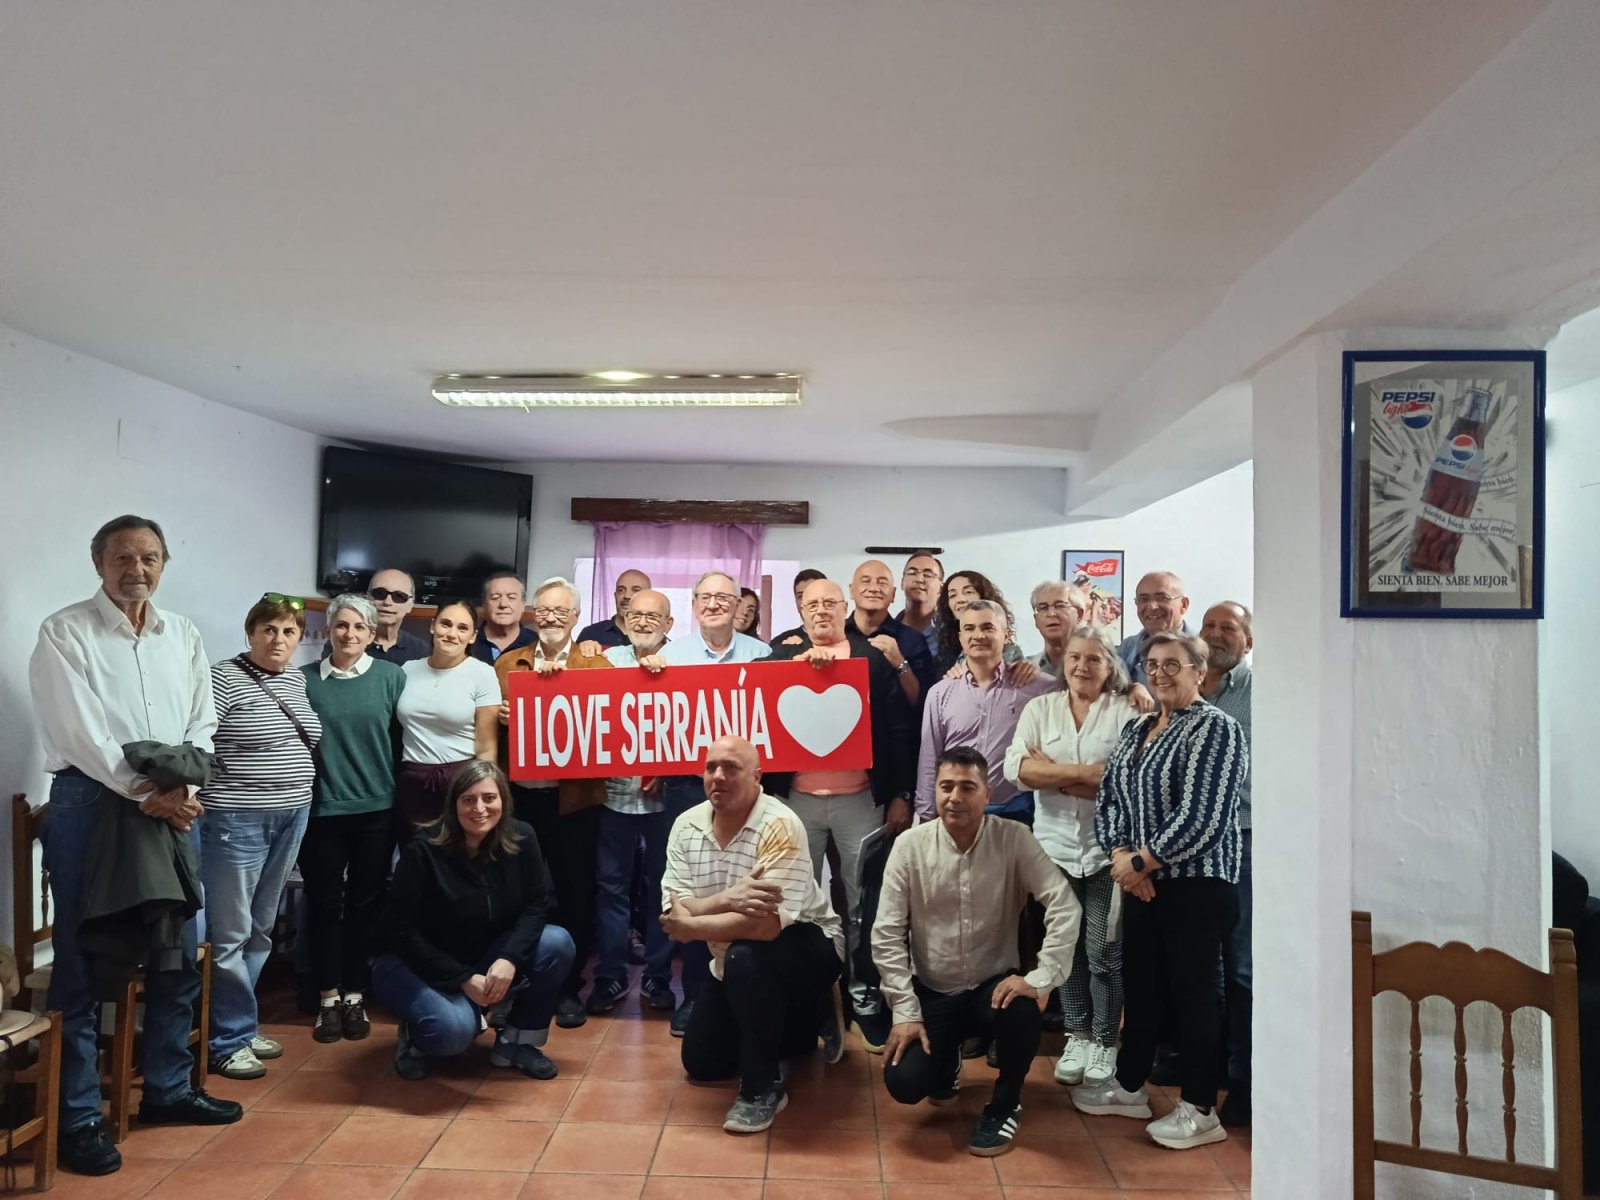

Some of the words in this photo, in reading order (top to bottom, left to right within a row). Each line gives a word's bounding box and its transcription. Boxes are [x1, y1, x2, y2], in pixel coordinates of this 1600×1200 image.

[1381, 391, 1435, 403] PEPSI
[1436, 457, 1465, 470] PEPSI
[1470, 523, 1489, 531] Sabe
[1377, 575, 1413, 586] SIENTA
[1416, 575, 1443, 586] BIEN.
[1446, 575, 1471, 586] SABE
[1474, 575, 1508, 589] MEJOR
[517, 697, 525, 767] I
[535, 694, 612, 768] LOVE
[620, 667, 774, 765] SERRANÍA
